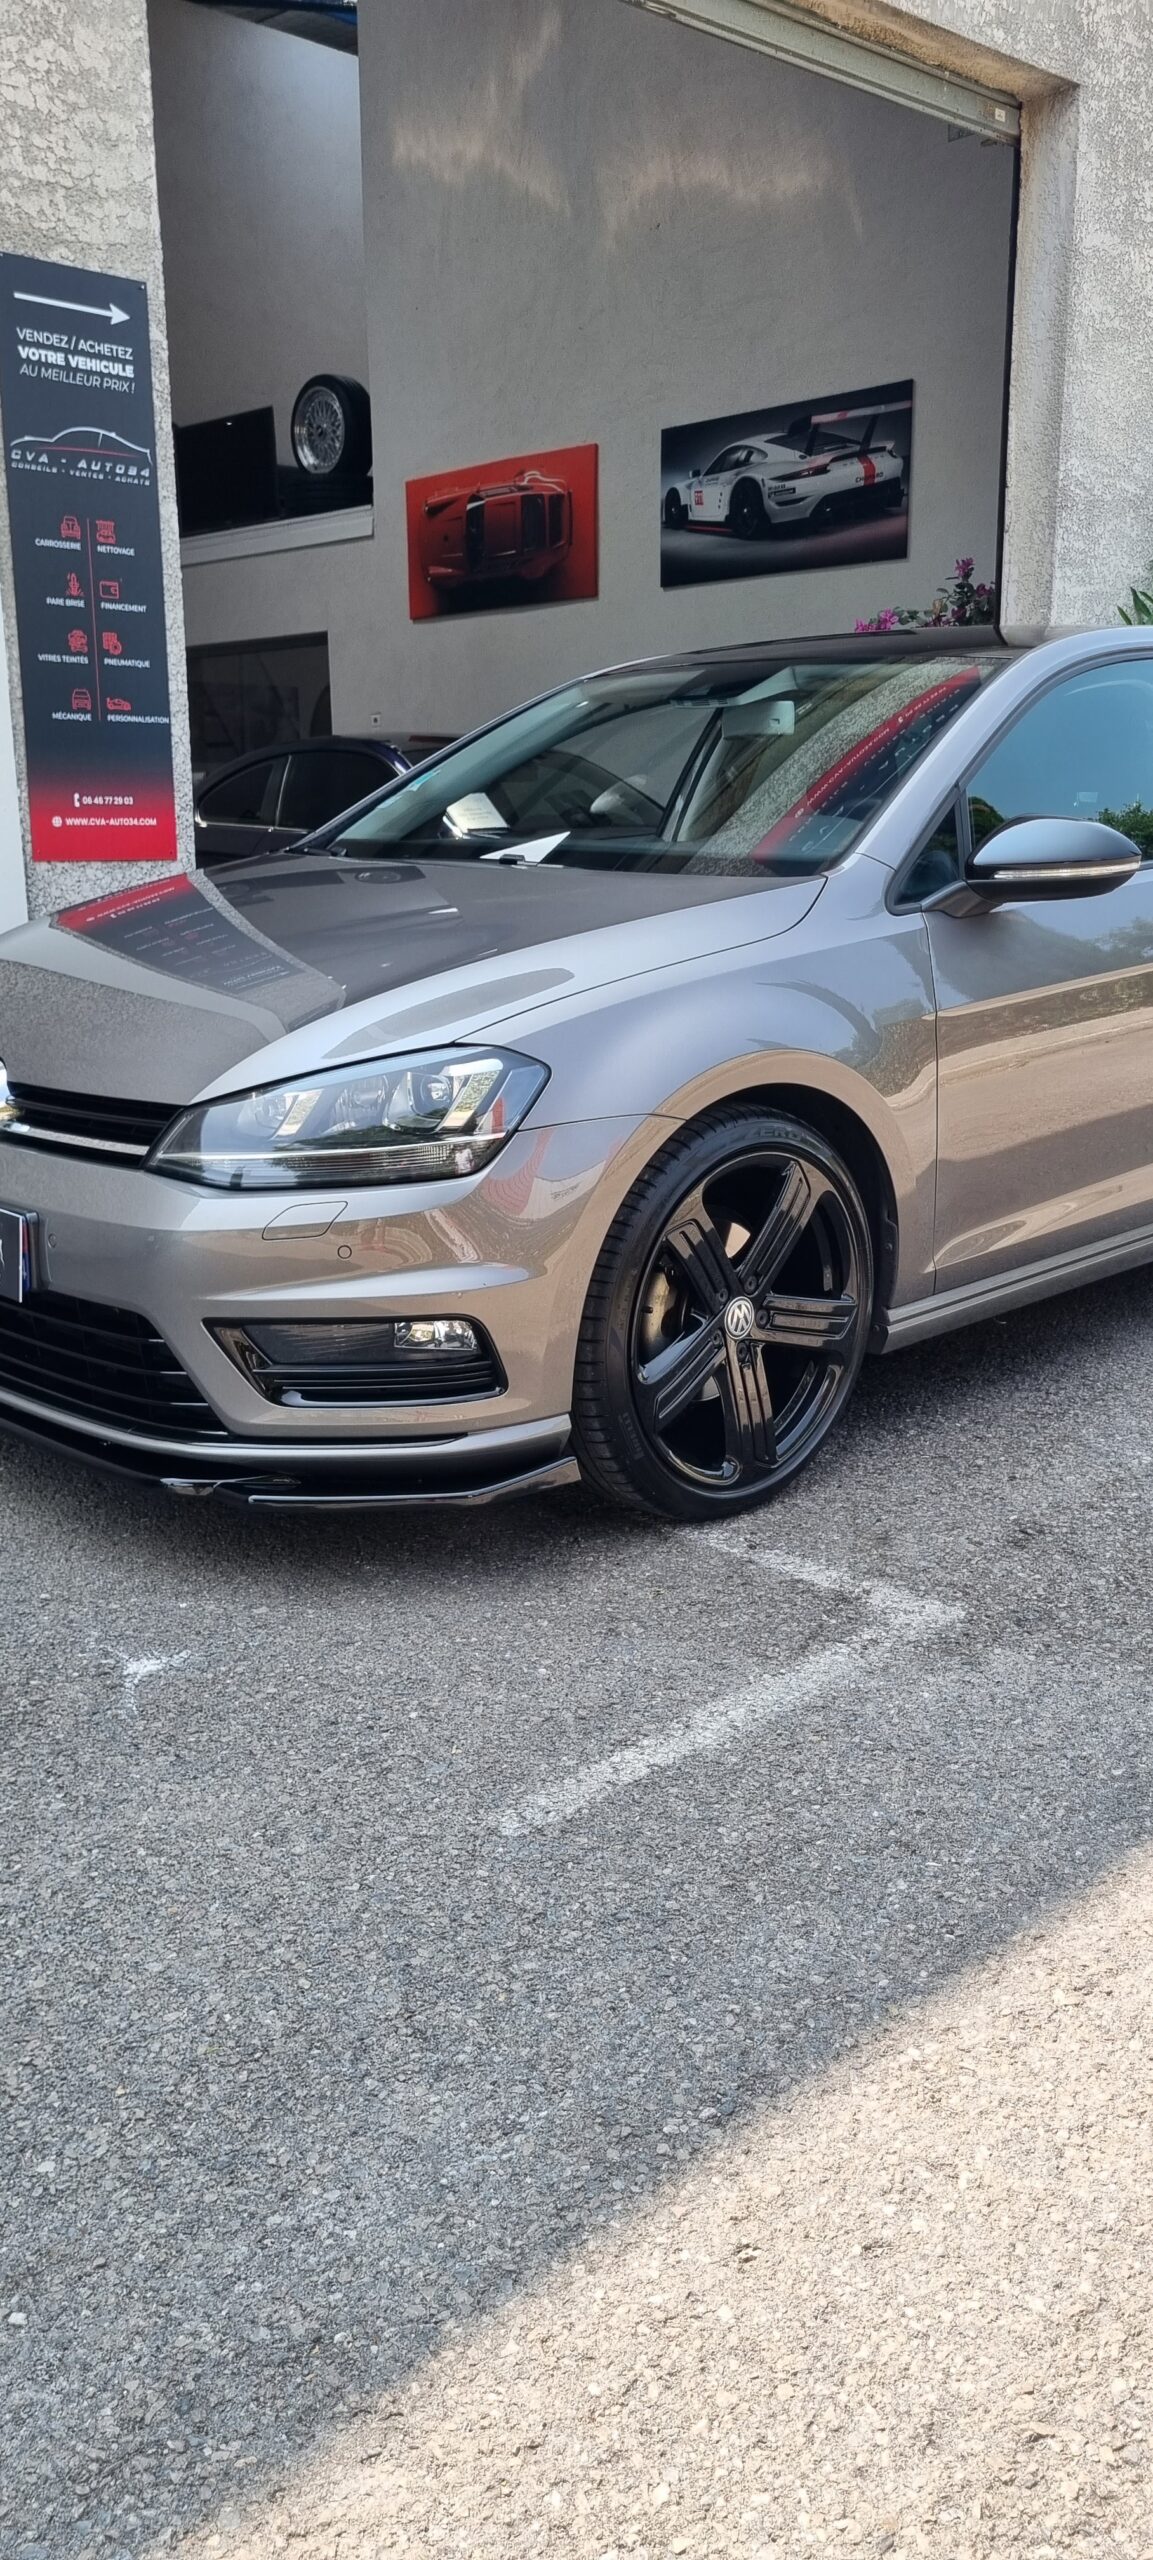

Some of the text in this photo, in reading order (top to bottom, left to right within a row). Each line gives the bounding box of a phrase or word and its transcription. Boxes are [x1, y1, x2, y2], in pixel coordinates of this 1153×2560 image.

[16, 327, 69, 349] VENDEZ
[78, 339, 134, 360] ACHETEZ
[17, 345, 135, 378] VOTRE VEHICULE
[19, 363, 39, 377] AU
[40, 367, 101, 388] MEILLEUR
[11, 449, 49, 464] CVA
[77, 458, 151, 478] AUTO34
[34, 538, 82, 551] CARROSSERIE
[96, 545, 136, 557] NETTOYAGE
[46, 596, 86, 609] PARE BRISE
[100, 601, 148, 613] FINANCEMENT
[37, 653, 62, 664] VITRES
[103, 657, 151, 669] PNEUMATIQUE
[52, 711, 93, 722] MÉCANIQUE
[107, 713, 170, 725] PERSONNALISATION
[104, 796, 114, 805] 77
[65, 817, 158, 827] WWW.CVA-AUTO34.COM
